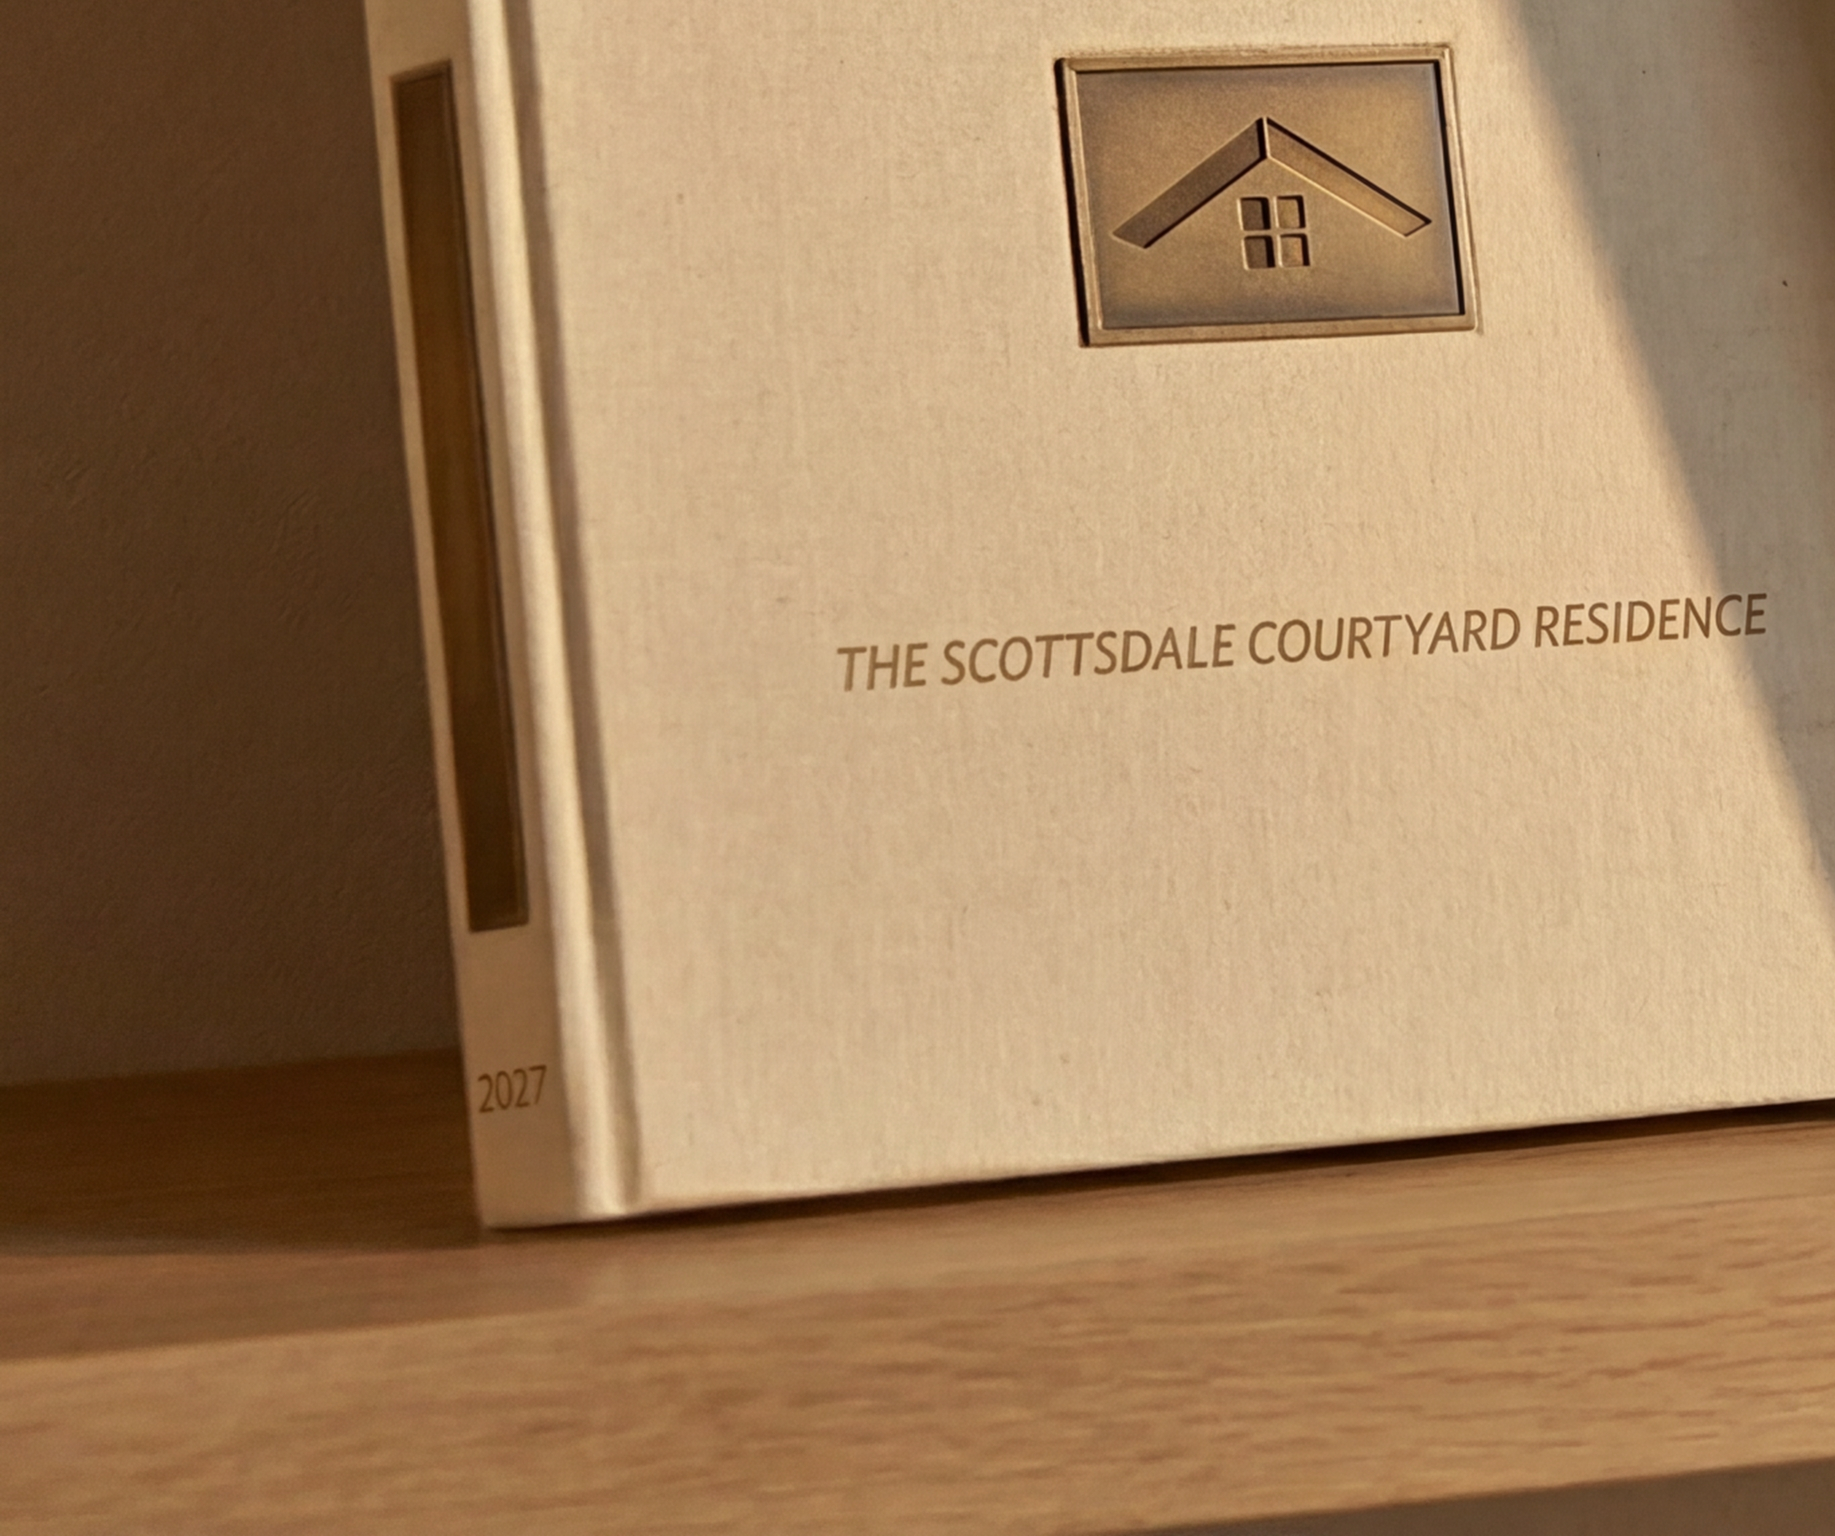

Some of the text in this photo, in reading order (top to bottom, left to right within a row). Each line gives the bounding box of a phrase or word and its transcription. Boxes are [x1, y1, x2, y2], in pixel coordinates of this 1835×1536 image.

[837, 592, 1768, 692] THE SCOTTSDALE COURTYARD RESIDENCE
[477, 1065, 548, 1113] 2027
